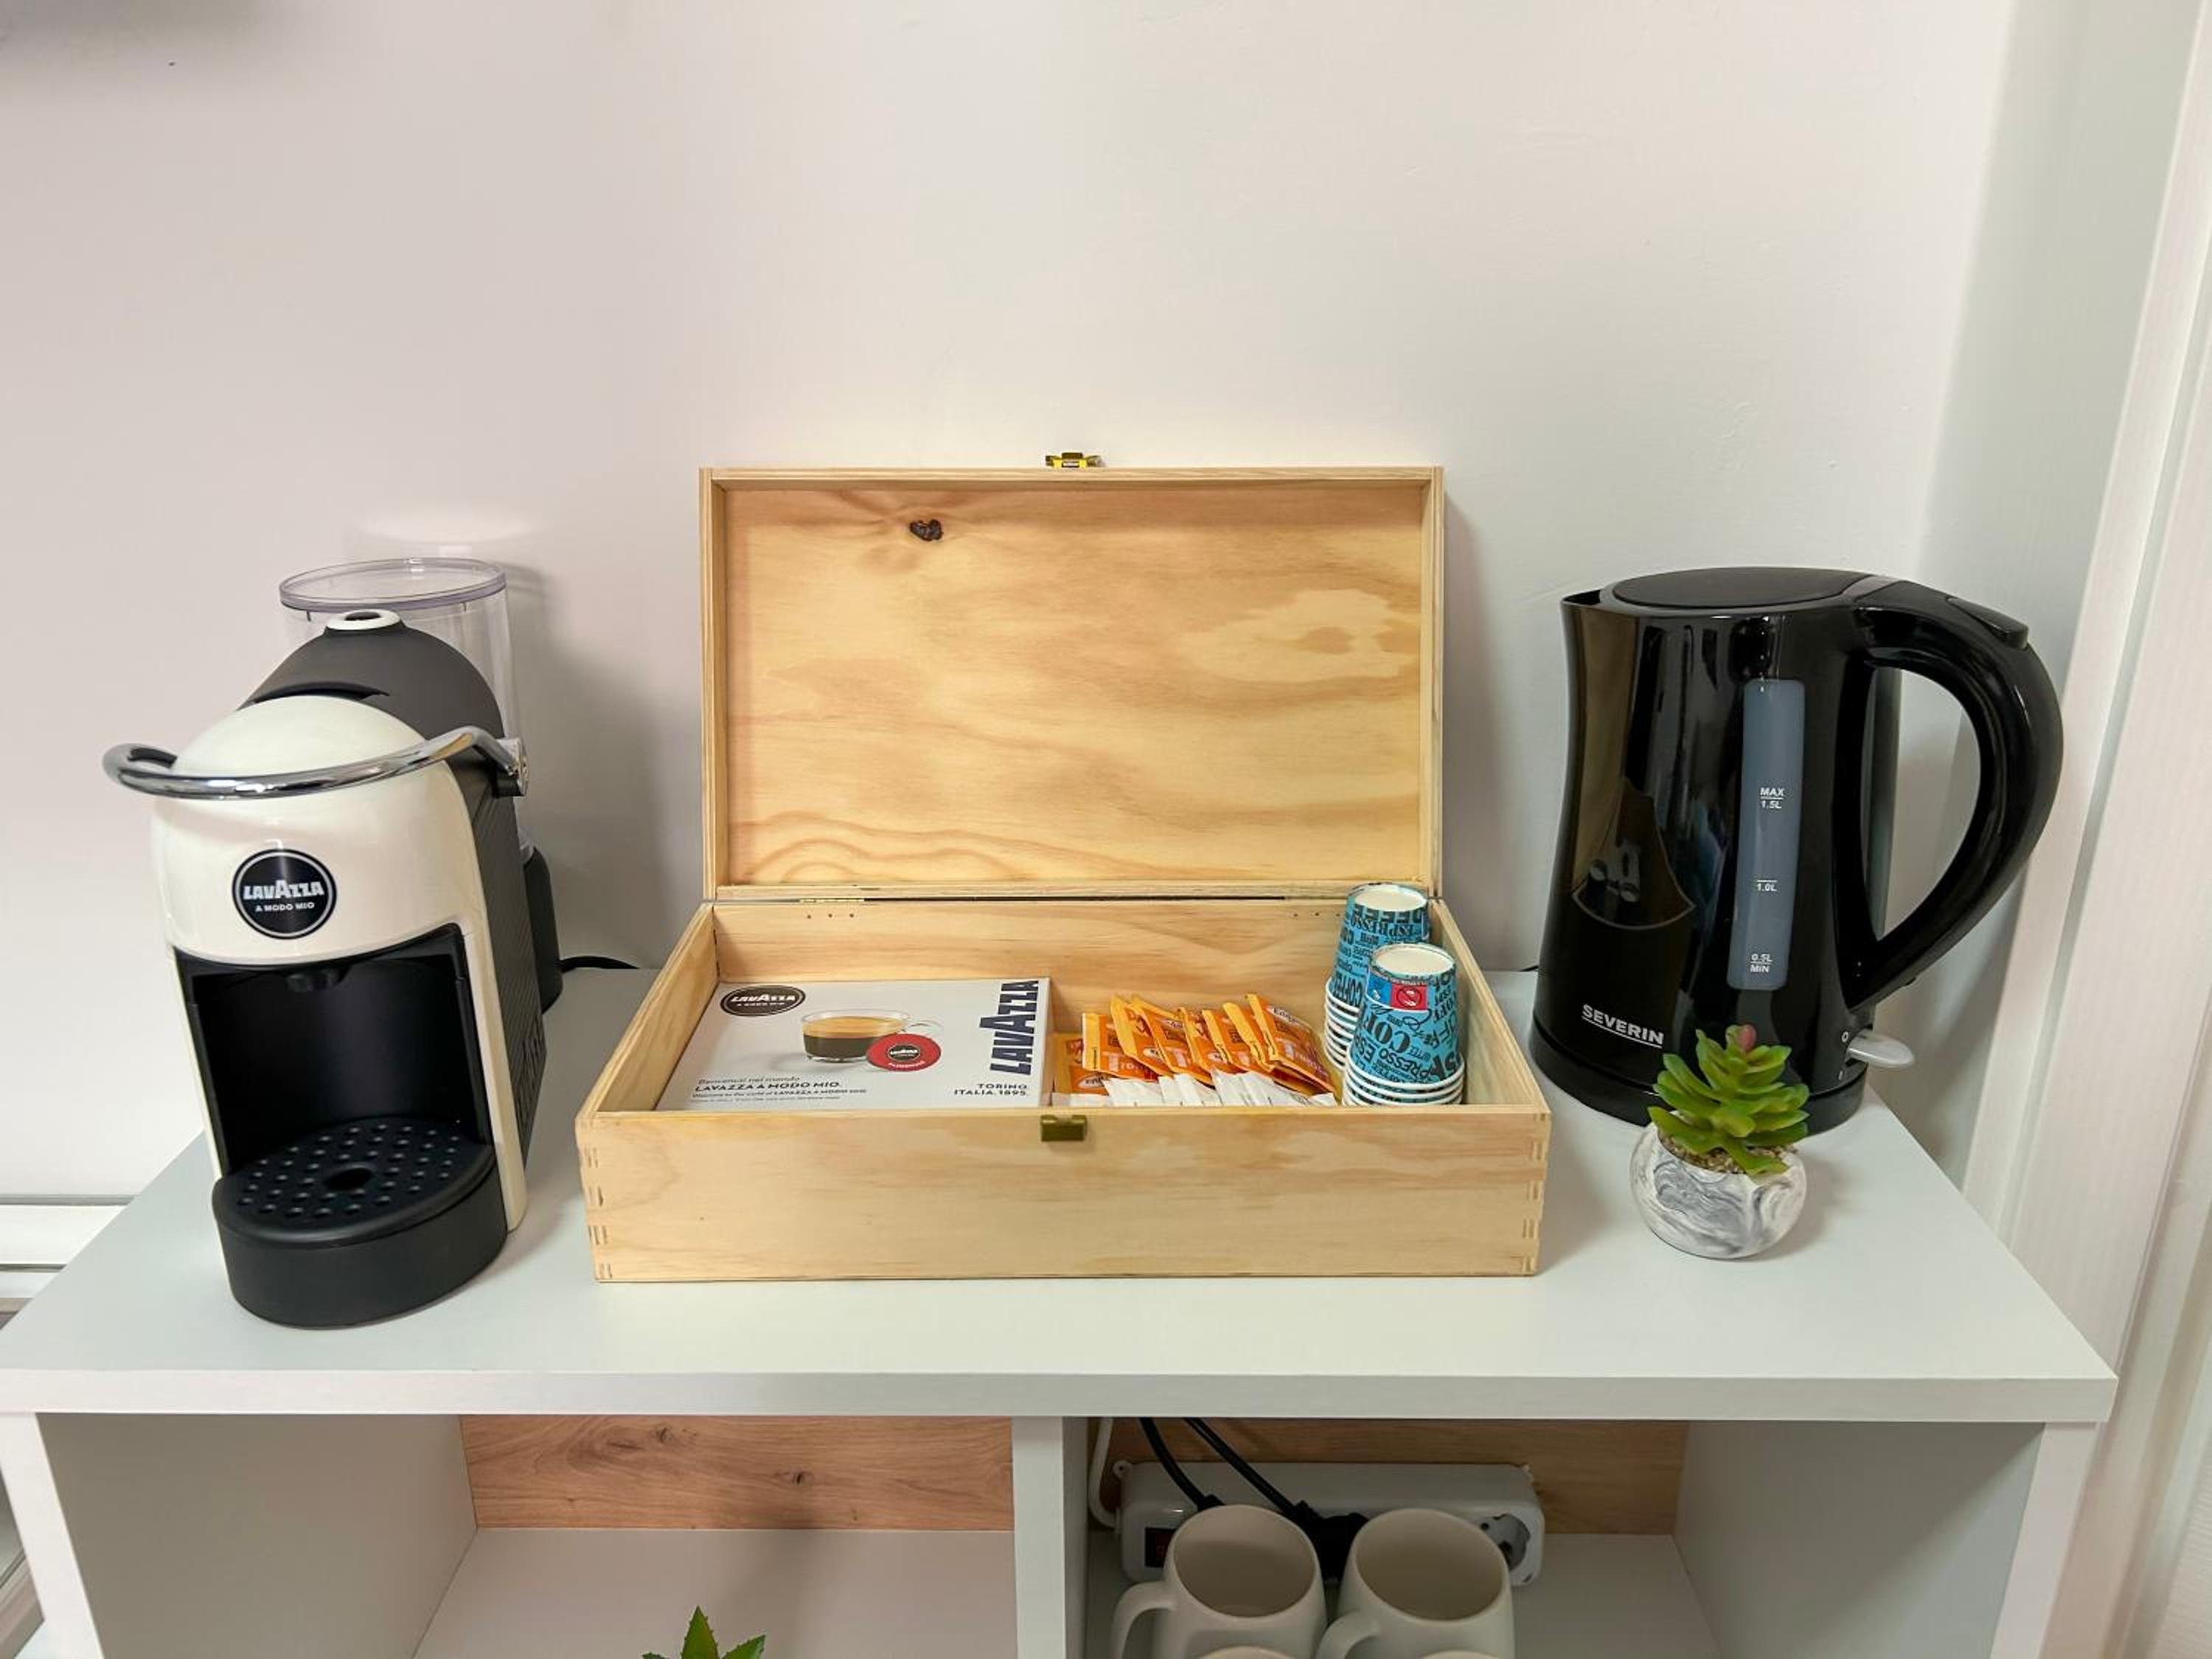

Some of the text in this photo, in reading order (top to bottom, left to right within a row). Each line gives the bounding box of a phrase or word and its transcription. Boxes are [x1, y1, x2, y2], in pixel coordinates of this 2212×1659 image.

[1760, 787, 1784, 796] MAX
[1761, 800, 1782, 809] 1.5L
[243, 880, 324, 900] LAVAZZA
[1757, 883, 1777, 891] 1.0L
[264, 903, 293, 911] MODO
[295, 902, 315, 910] MIO
[1750, 964, 1770, 973] MIN
[979, 980, 1039, 1076] LAVAZZA
[1582, 1004, 1664, 1046] SEVERIN
[768, 1082, 810, 1090] MODO
